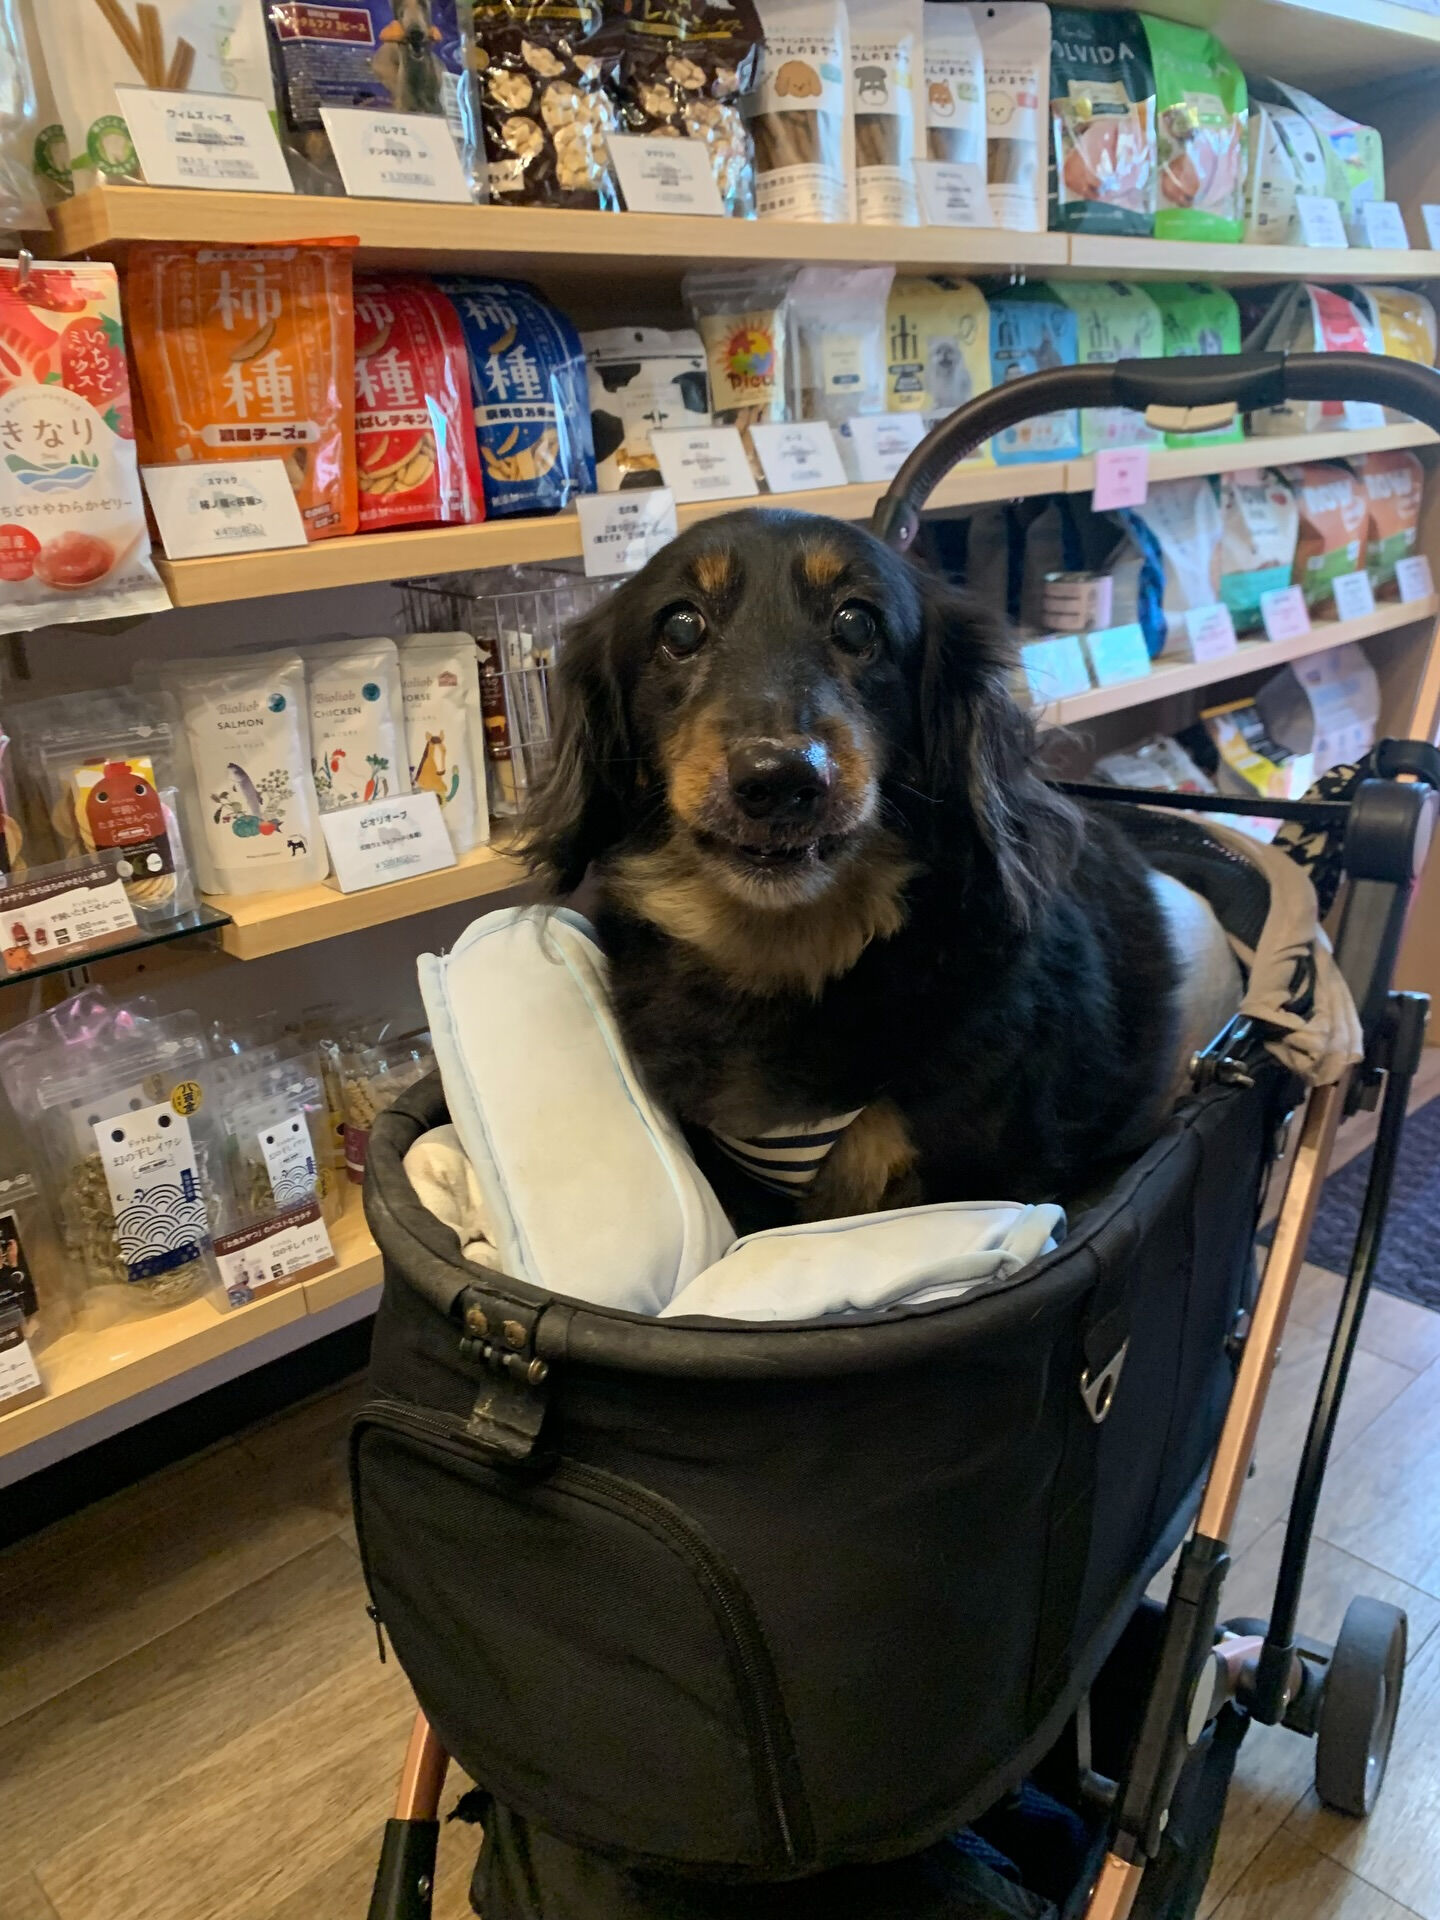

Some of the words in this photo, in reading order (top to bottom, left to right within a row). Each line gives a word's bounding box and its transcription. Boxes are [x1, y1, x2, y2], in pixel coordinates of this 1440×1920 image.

[70, 330, 95, 388] ミックス
[84, 329, 113, 392] いちご
[0, 418, 93, 450] きなり
[217, 718, 264, 730] SALMON
[313, 706, 362, 719] CHICKEN
